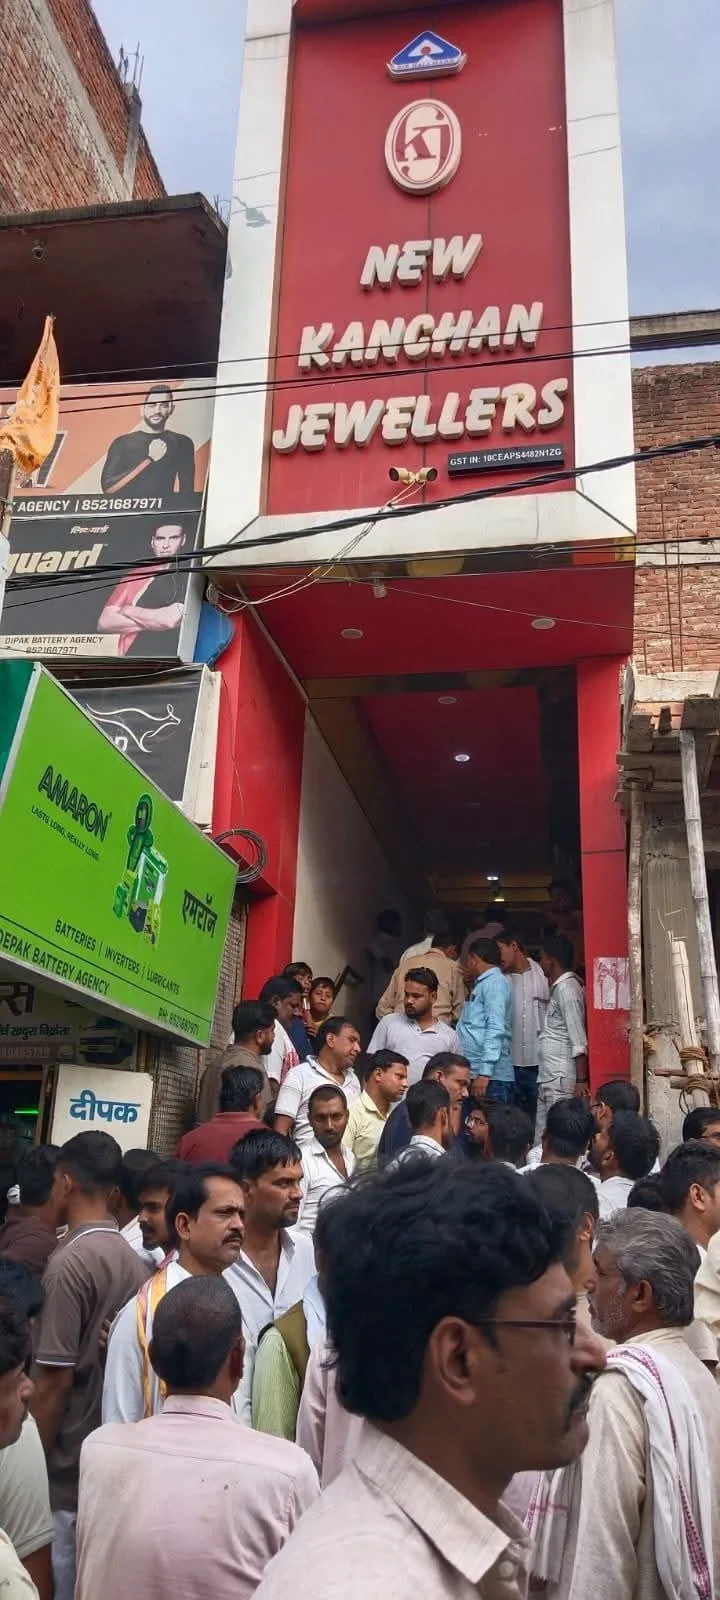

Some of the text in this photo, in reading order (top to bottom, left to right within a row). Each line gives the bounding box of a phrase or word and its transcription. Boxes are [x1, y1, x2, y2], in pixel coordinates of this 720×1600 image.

[360, 233, 483, 289] NEW
[298, 301, 543, 370] KANCHAN
[272, 378, 568, 452] JEWELLERS
[450, 457, 468, 466] GST
[469, 456, 481, 465] IN:
[17, 498, 163, 512] AGENCY 8521687971
[5, 636, 104, 645] DIPAK BATTERY AGENCY
[38, 765, 109, 842] AMARON
[66, 832, 86, 850] REALLY
[31, 947, 76, 981] BATTERY
[74, 969, 110, 996] AGENCY
[55, 919, 180, 995] BATTERIES INVERTERS LUBRICANTS
[69, 1089, 141, 1123] दीपक
